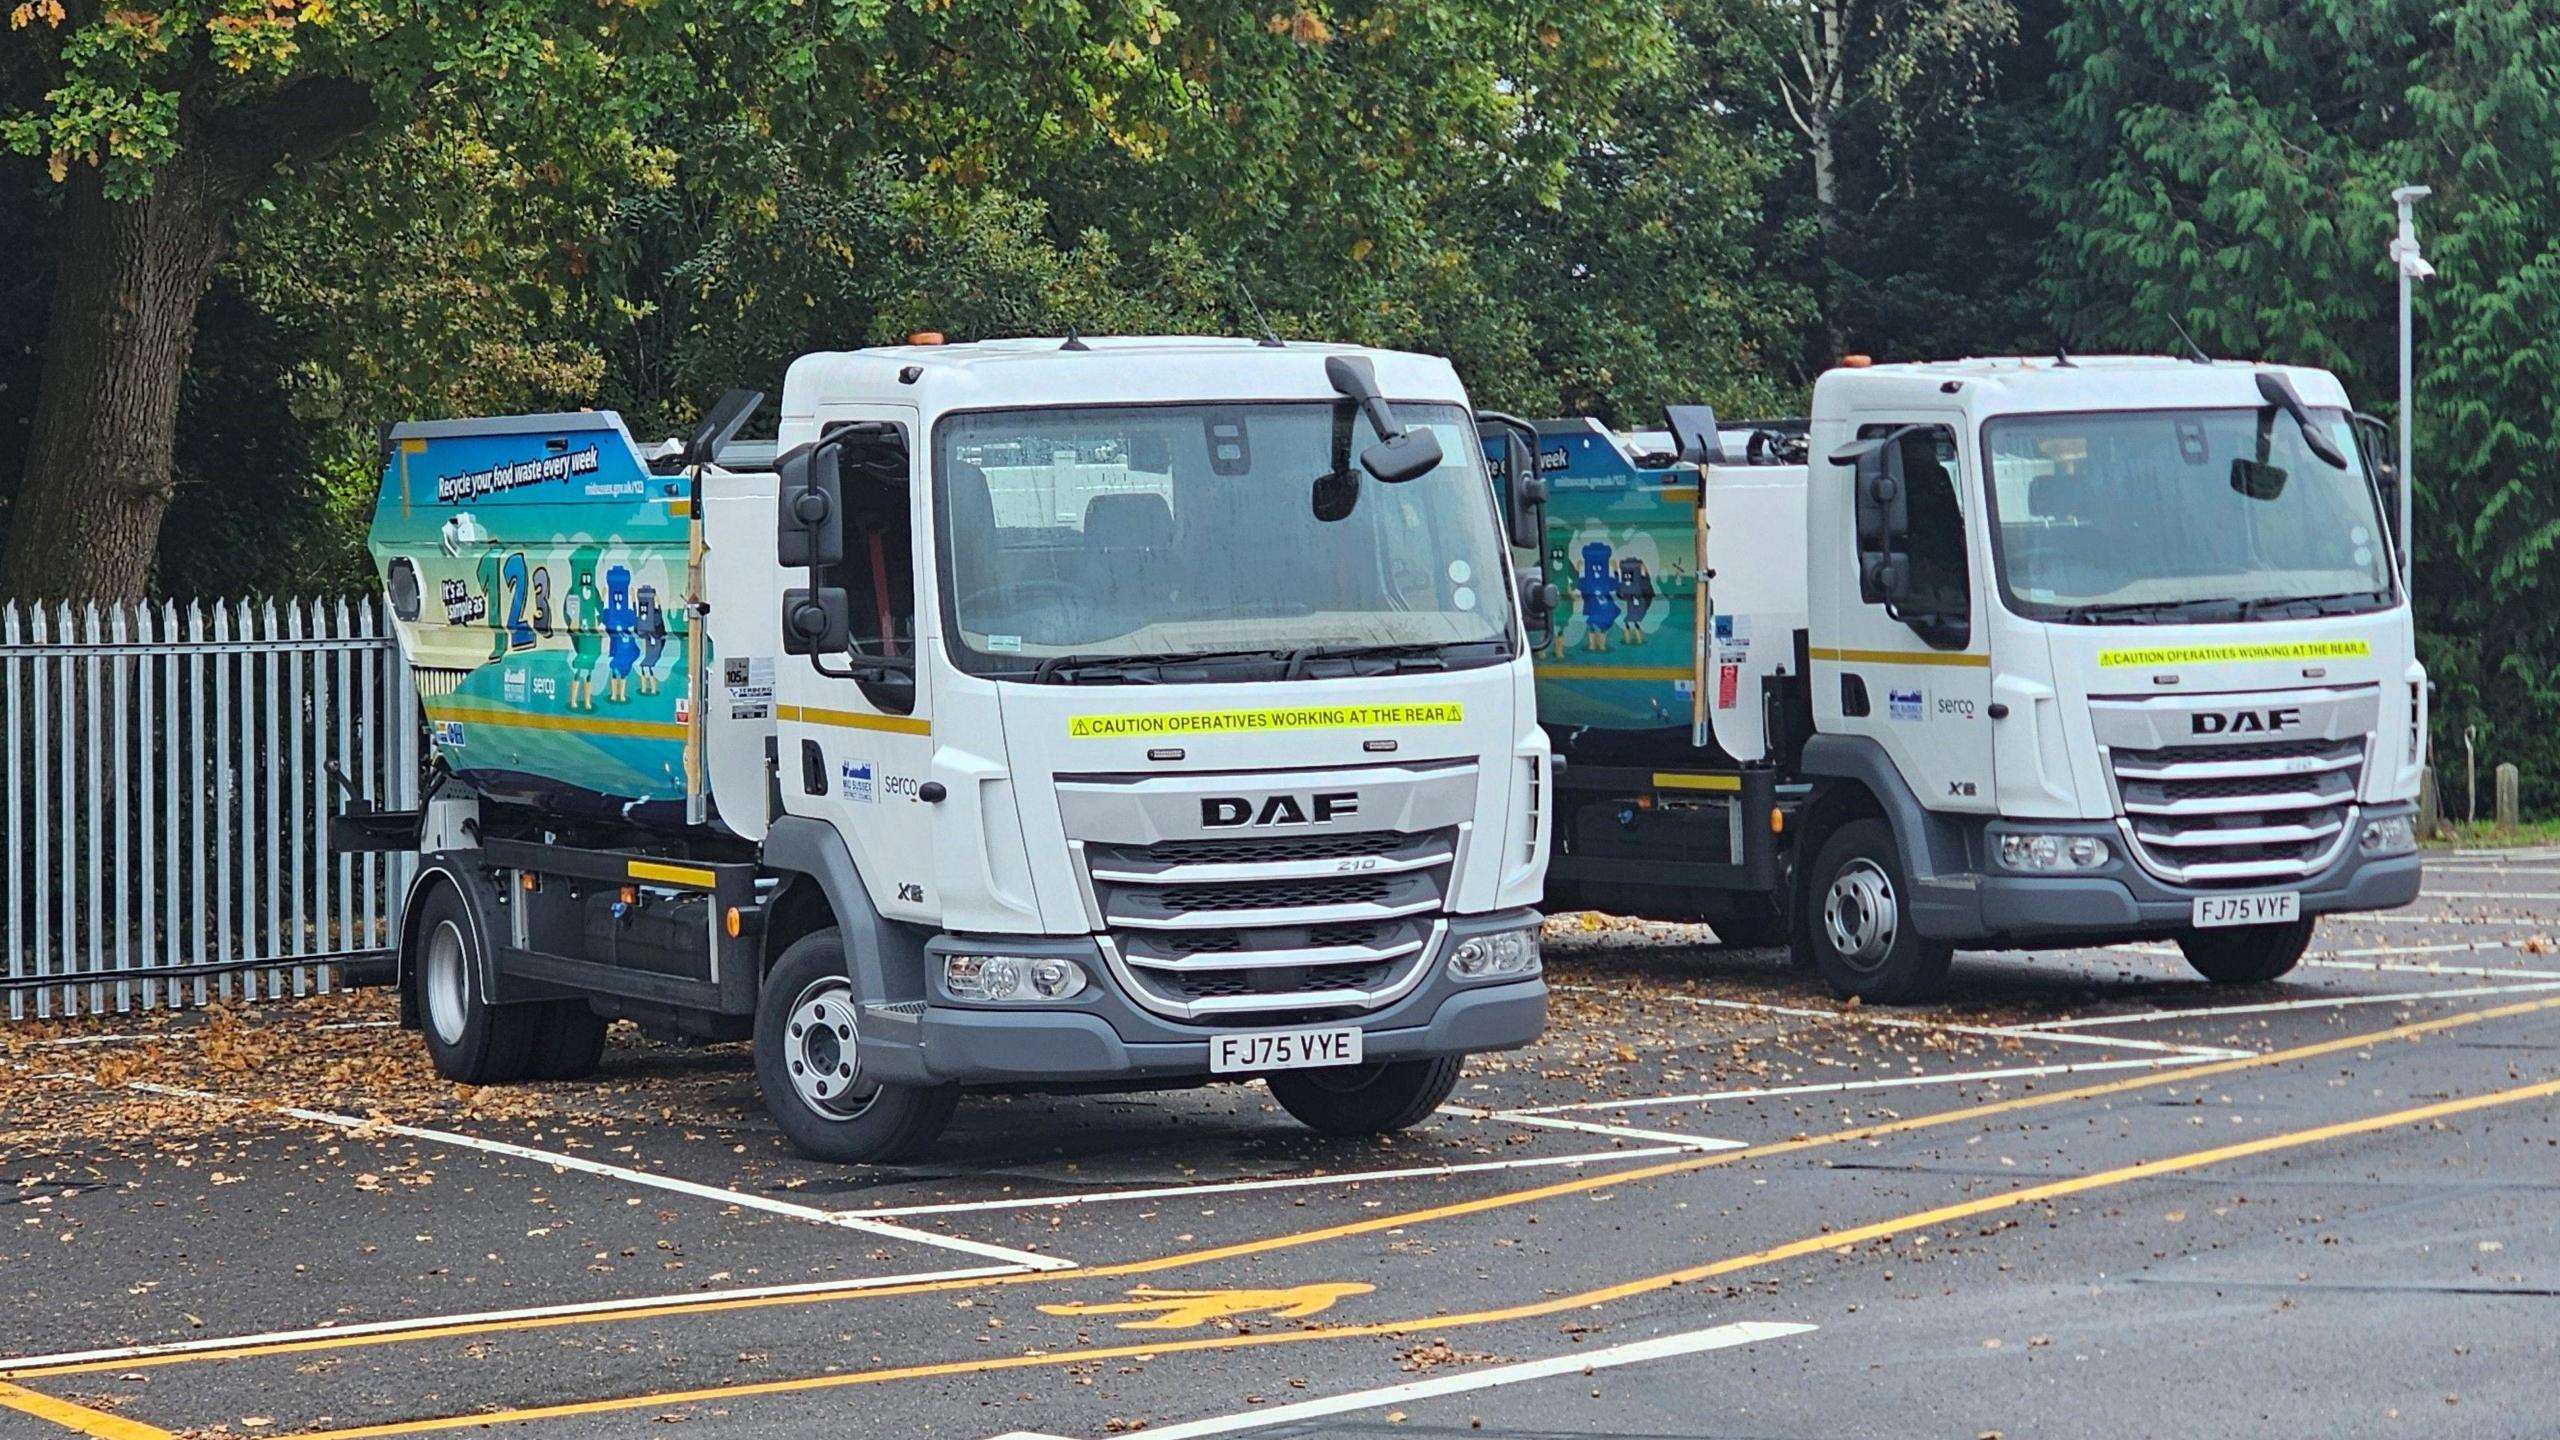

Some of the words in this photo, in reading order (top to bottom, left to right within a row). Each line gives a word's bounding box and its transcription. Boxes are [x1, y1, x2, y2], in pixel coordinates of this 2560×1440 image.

[438, 470, 471, 500] Recycle
[471, 472, 492, 498] your
[494, 463, 513, 487] food
[515, 461, 542, 482] waste
[543, 455, 569, 480] every
[572, 445, 598, 470] week
[456, 581, 465, 597] as
[449, 599, 472, 622] simple
[474, 597, 483, 613] as
[2114, 651, 2164, 664] CAUTION
[2167, 648, 2236, 661] OPERATIVES
[2239, 645, 2289, 659] WORKING
[2293, 644, 2306, 656] AT
[2309, 643, 2326, 655] THE
[2330, 641, 2358, 654] REAR
[533, 677, 556, 695] serco
[727, 670, 742, 683] 105
[1938, 698, 1975, 714] serco
[1092, 717, 1164, 734] CAUTION
[1168, 713, 1267, 730] OPERATIVES
[1271, 710, 1345, 727] WORKING
[1349, 709, 1369, 723] AT
[1373, 708, 1401, 722] THE
[1405, 706, 1446, 721] REAR
[2191, 708, 2301, 736] DAF
[884, 775, 918, 796] serco
[1200, 791, 1359, 830] DAF
[1337, 858, 1376, 872] 210
[2202, 898, 2250, 922] FJ75
[2256, 895, 2291, 918] VYF
[1222, 1036, 1292, 1066] FJ75
[1300, 1032, 1351, 1061] VYE
